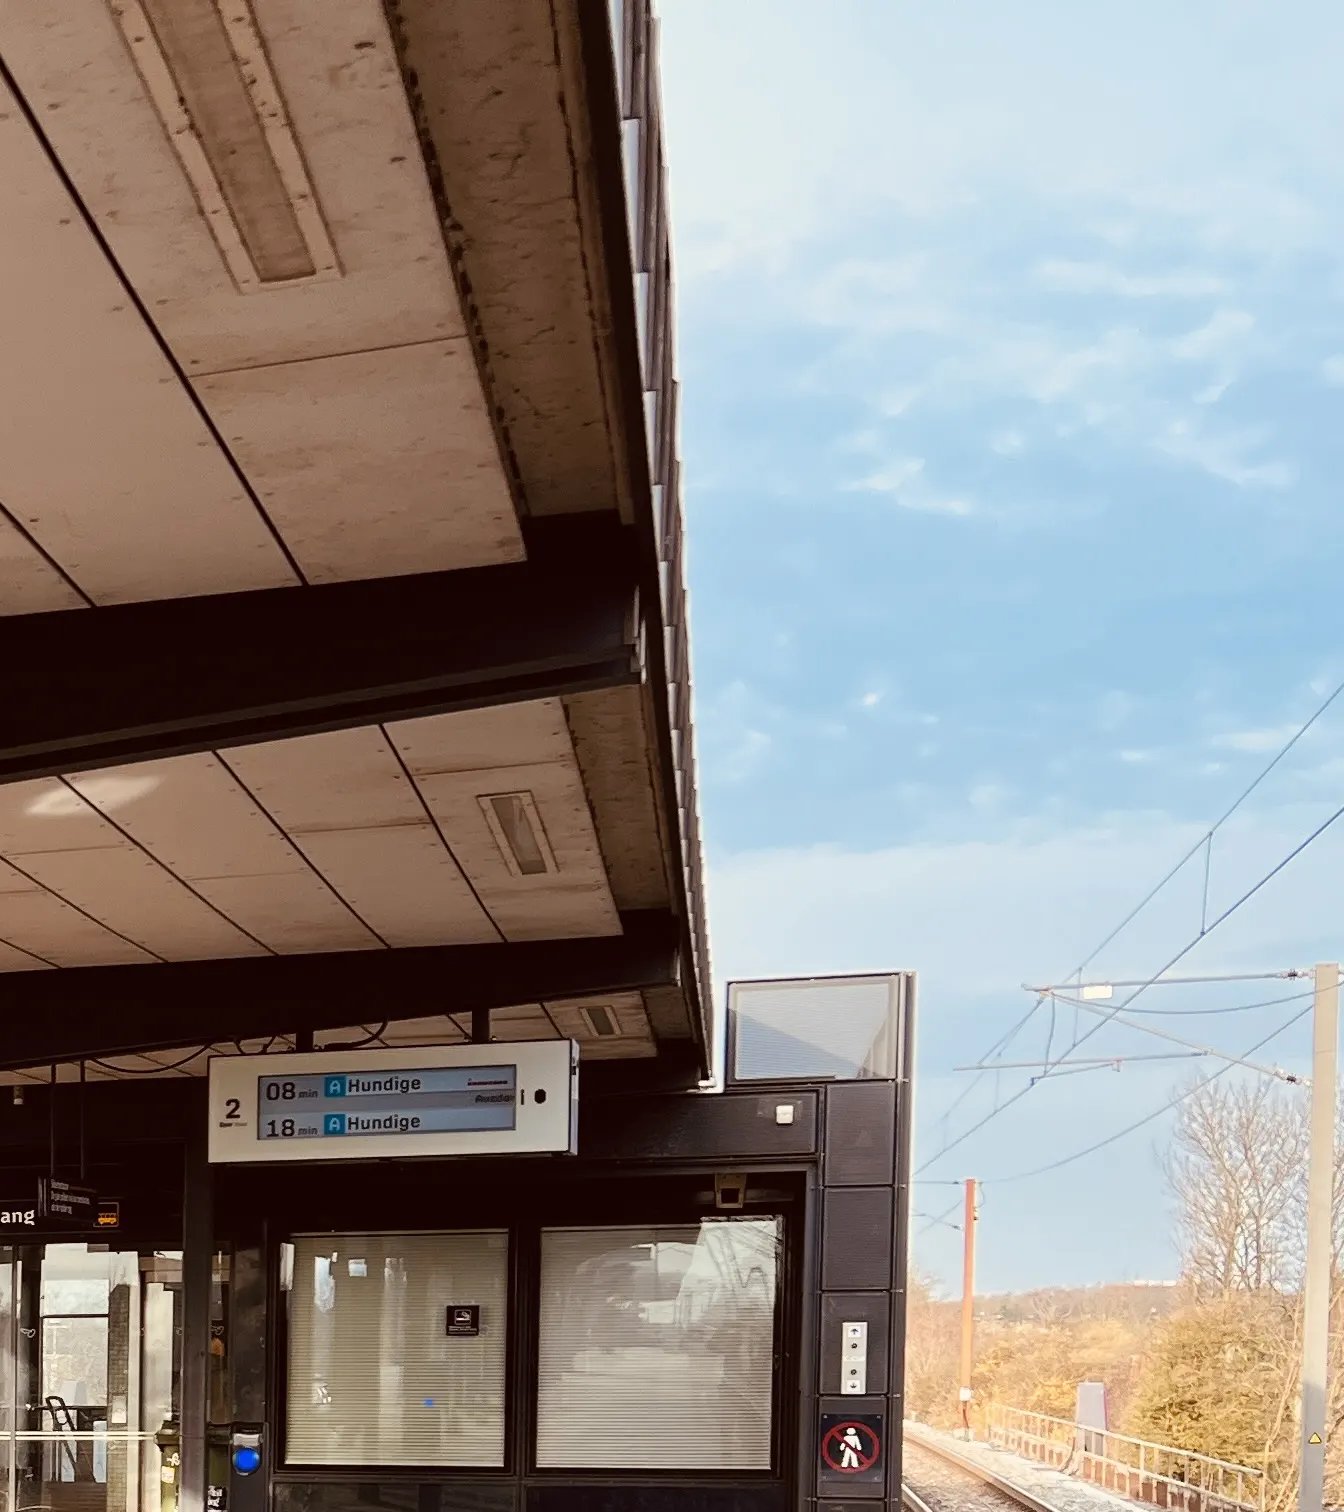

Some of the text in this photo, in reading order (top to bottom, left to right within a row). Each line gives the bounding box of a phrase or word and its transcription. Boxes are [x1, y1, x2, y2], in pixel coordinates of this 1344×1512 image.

[266, 1076, 421, 1101] 08 min A Hundige
[225, 1098, 241, 1119] 2
[266, 1118, 295, 1137] 18
[298, 1126, 318, 1136] min
[329, 1117, 341, 1132] A
[348, 1113, 421, 1132] Hundige
